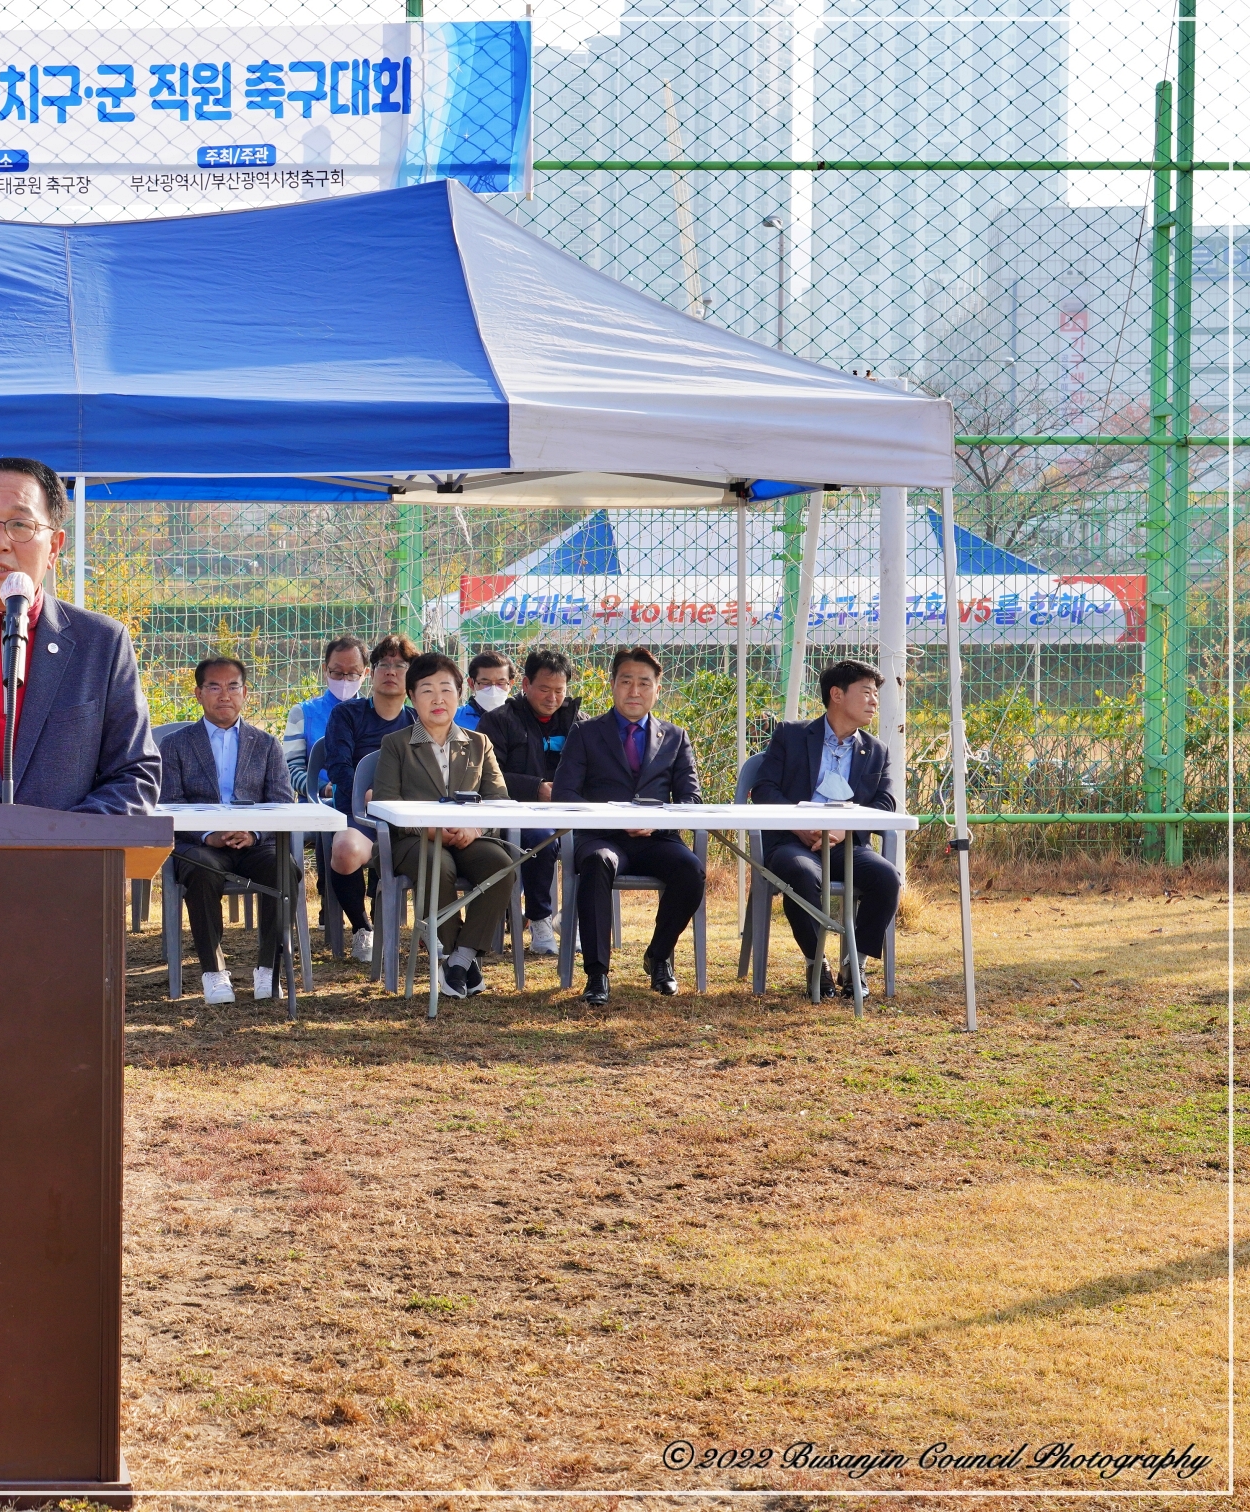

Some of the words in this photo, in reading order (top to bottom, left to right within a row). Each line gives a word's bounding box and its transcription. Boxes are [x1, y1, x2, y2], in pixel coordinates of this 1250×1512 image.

[148, 61, 233, 122] 직원
[245, 55, 412, 119] 축구대회
[204, 147, 269, 165] 주최/주관
[46, 175, 91, 195] 축구장
[130, 169, 345, 193] 부산광역시/부산광역시청축구회
[592, 594, 624, 625] 우
[629, 599, 661, 624] to
[666, 598, 717, 625] the
